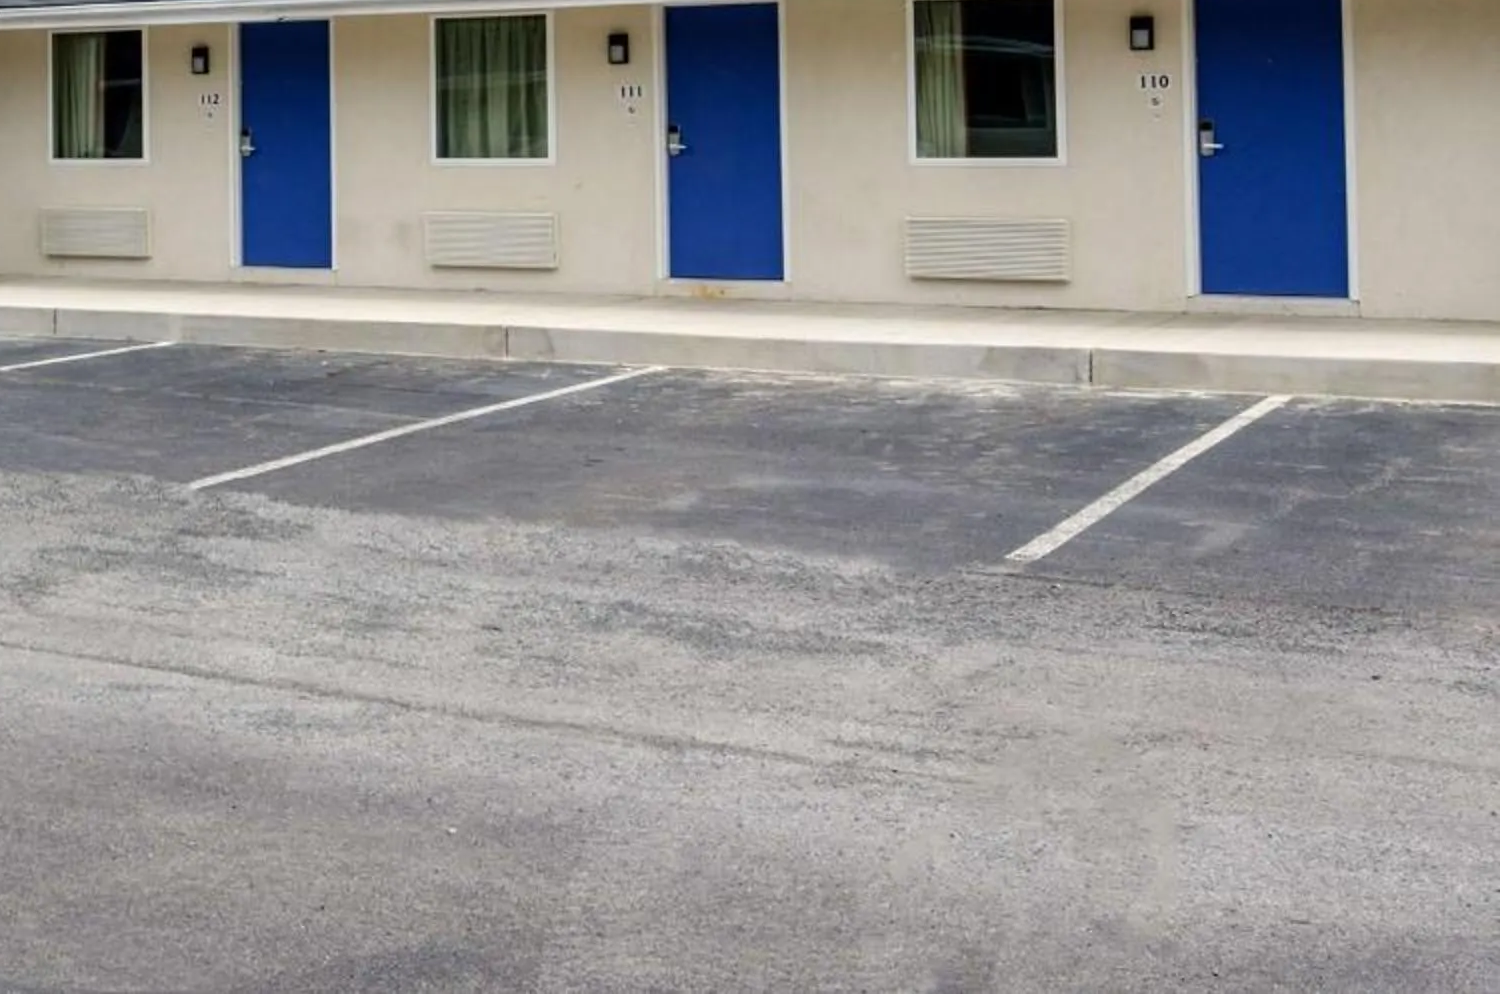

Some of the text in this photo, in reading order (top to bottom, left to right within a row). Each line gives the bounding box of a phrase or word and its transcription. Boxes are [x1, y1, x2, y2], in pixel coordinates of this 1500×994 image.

[1141, 75, 1169, 89] 110
[621, 85, 642, 98] 111
[201, 93, 219, 105] 112
